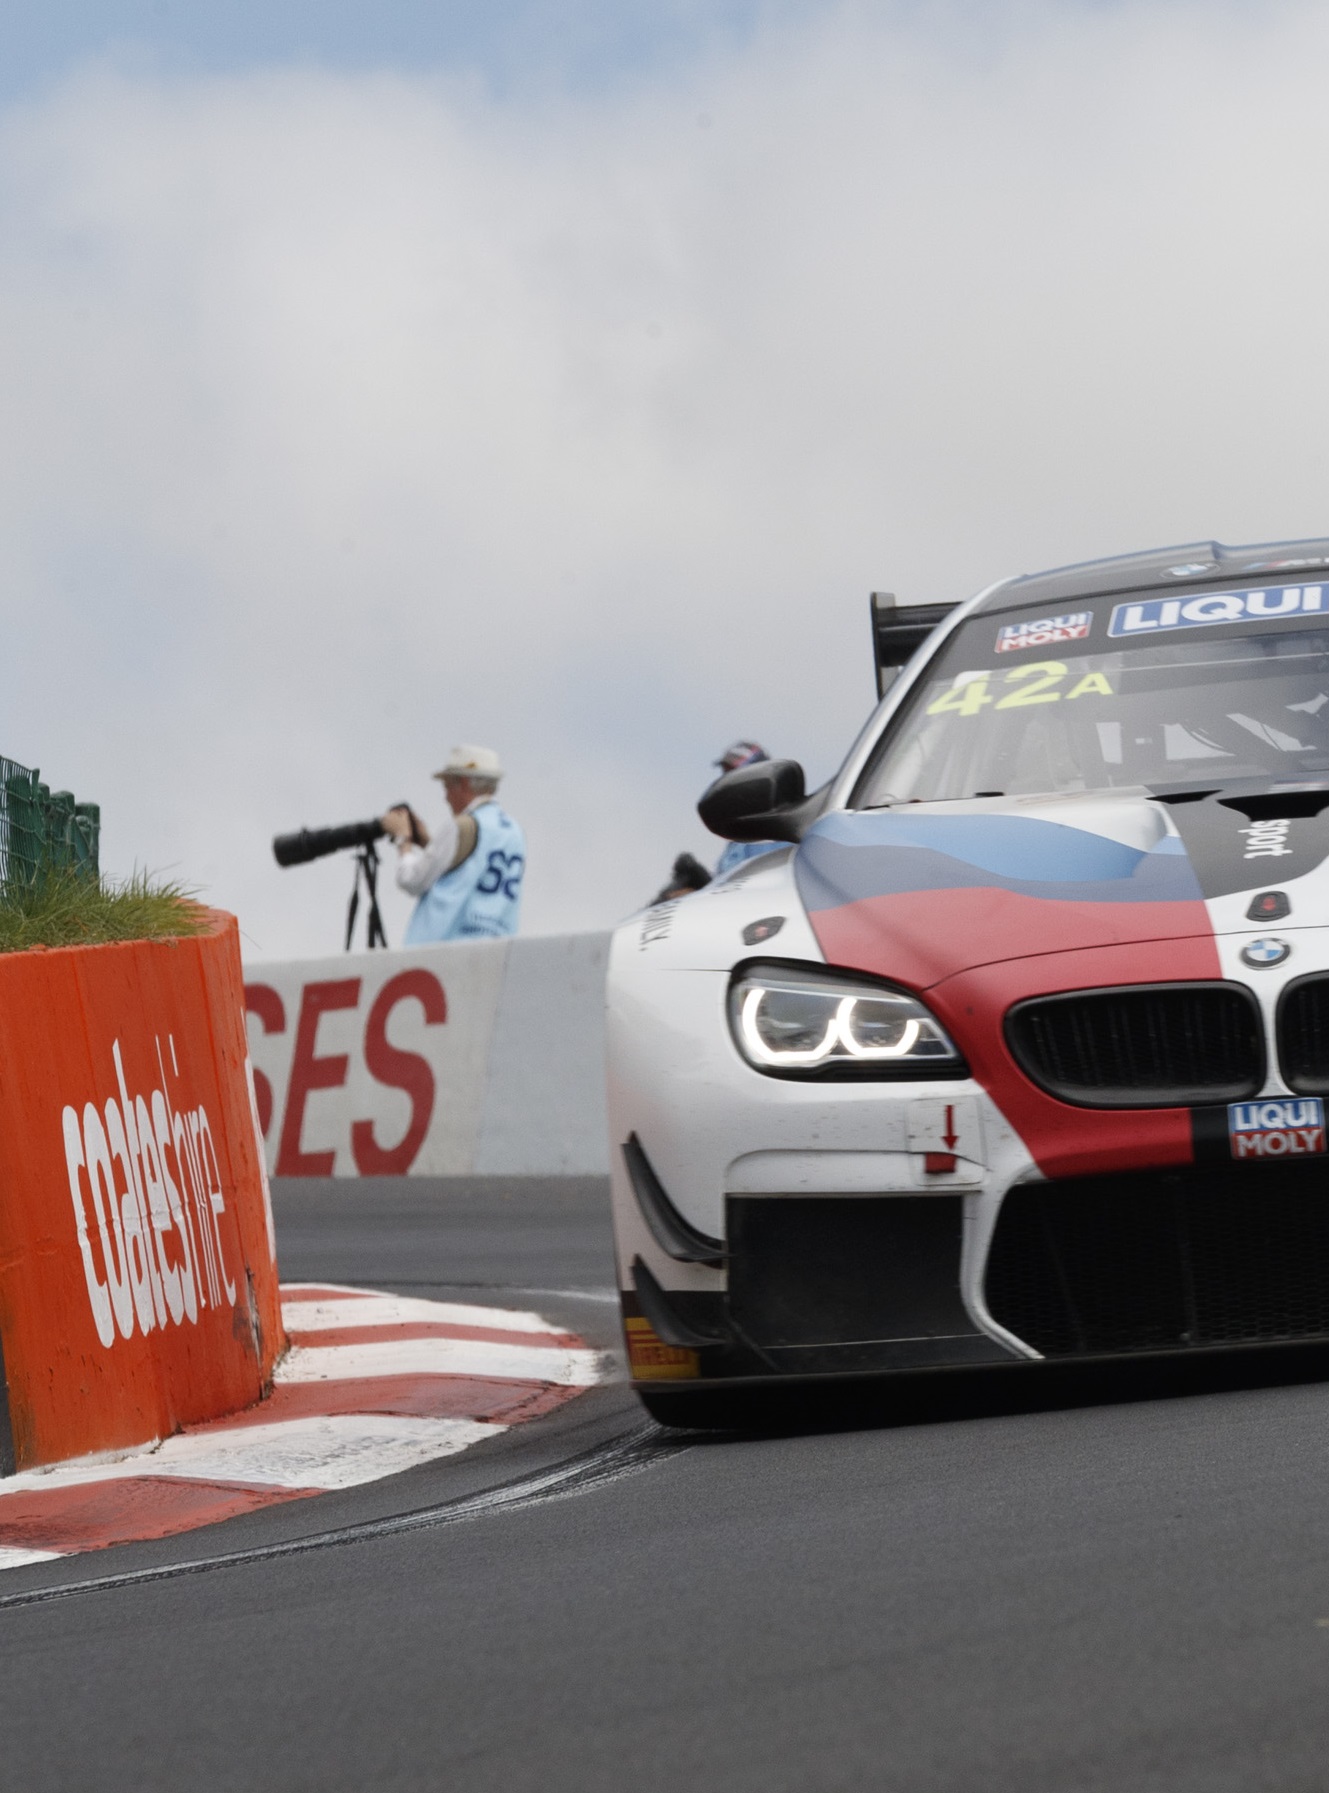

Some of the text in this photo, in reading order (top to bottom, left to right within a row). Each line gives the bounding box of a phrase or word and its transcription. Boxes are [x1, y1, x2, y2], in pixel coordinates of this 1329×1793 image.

[1122, 585, 1322, 630] LIQUI
[1001, 625, 1088, 651] MOLY
[1003, 613, 1088, 638] LIQUI
[1234, 1101, 1319, 1130] LIQUI
[1237, 1129, 1323, 1157] MOLY
